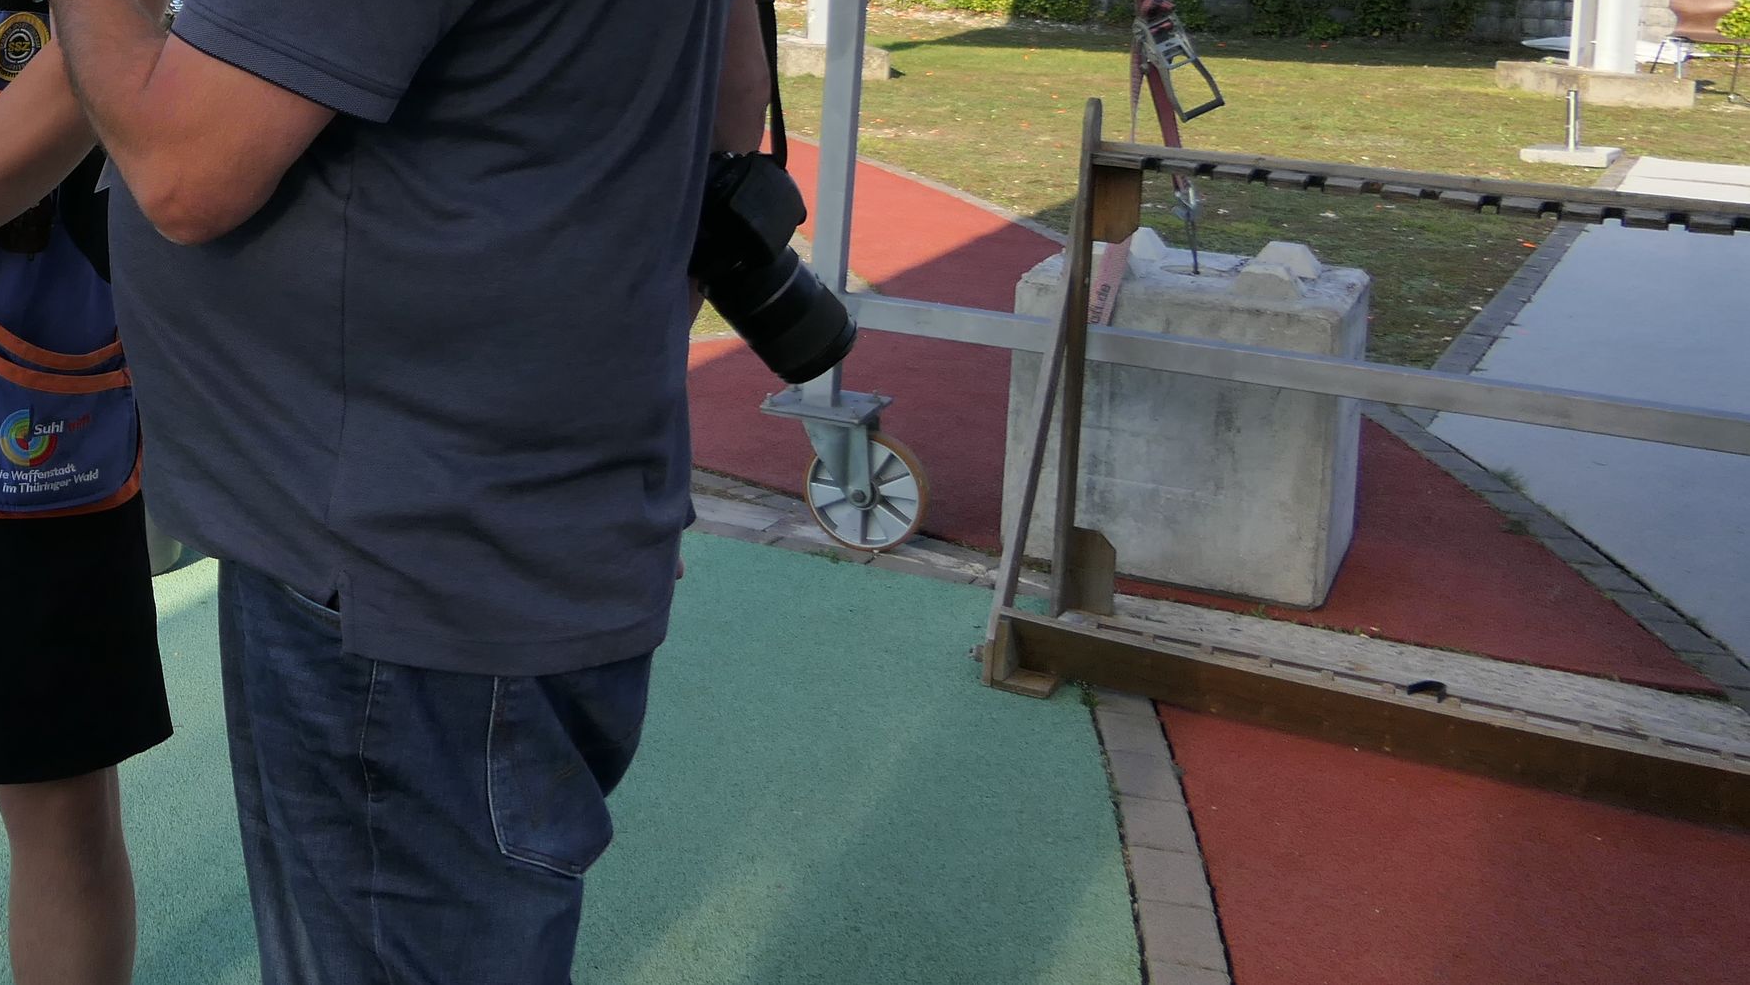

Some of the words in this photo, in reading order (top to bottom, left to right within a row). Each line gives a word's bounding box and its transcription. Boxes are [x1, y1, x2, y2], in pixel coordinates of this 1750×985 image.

[33, 420, 65, 435] Suhl
[2, 482, 17, 494] im
[18, 477, 72, 493] Thüringer
[73, 468, 100, 485] Wald
[10, 463, 77, 484] Waffenstadt
